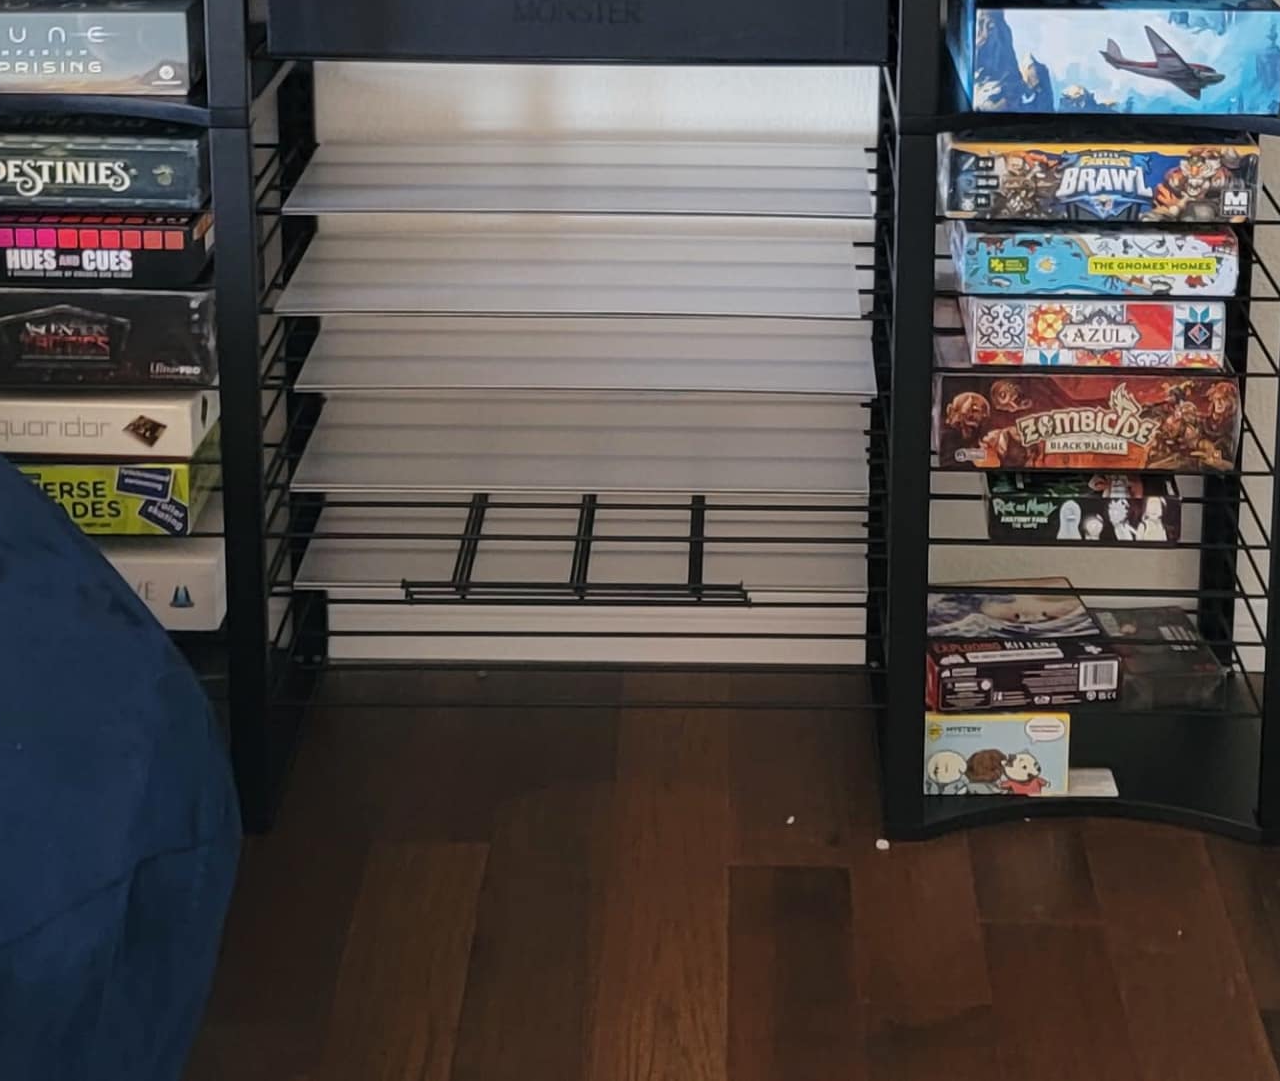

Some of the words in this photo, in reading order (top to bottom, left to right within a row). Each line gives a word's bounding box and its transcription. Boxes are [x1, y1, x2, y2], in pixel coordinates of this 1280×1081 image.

[1056, 166, 1154, 197] BRAWL
[6, 248, 58, 271] HUES
[81, 249, 133, 271] CUES
[1093, 261, 1115, 270] THE
[1118, 261, 1170, 271] GNOMES'
[1171, 262, 1213, 271] HOMES
[1072, 328, 1127, 343] AZUL
[1021, 394, 1156, 446] ZOMBICIDE
[1050, 442, 1080, 451] BLACK
[1084, 442, 1124, 451] PLAGUE
